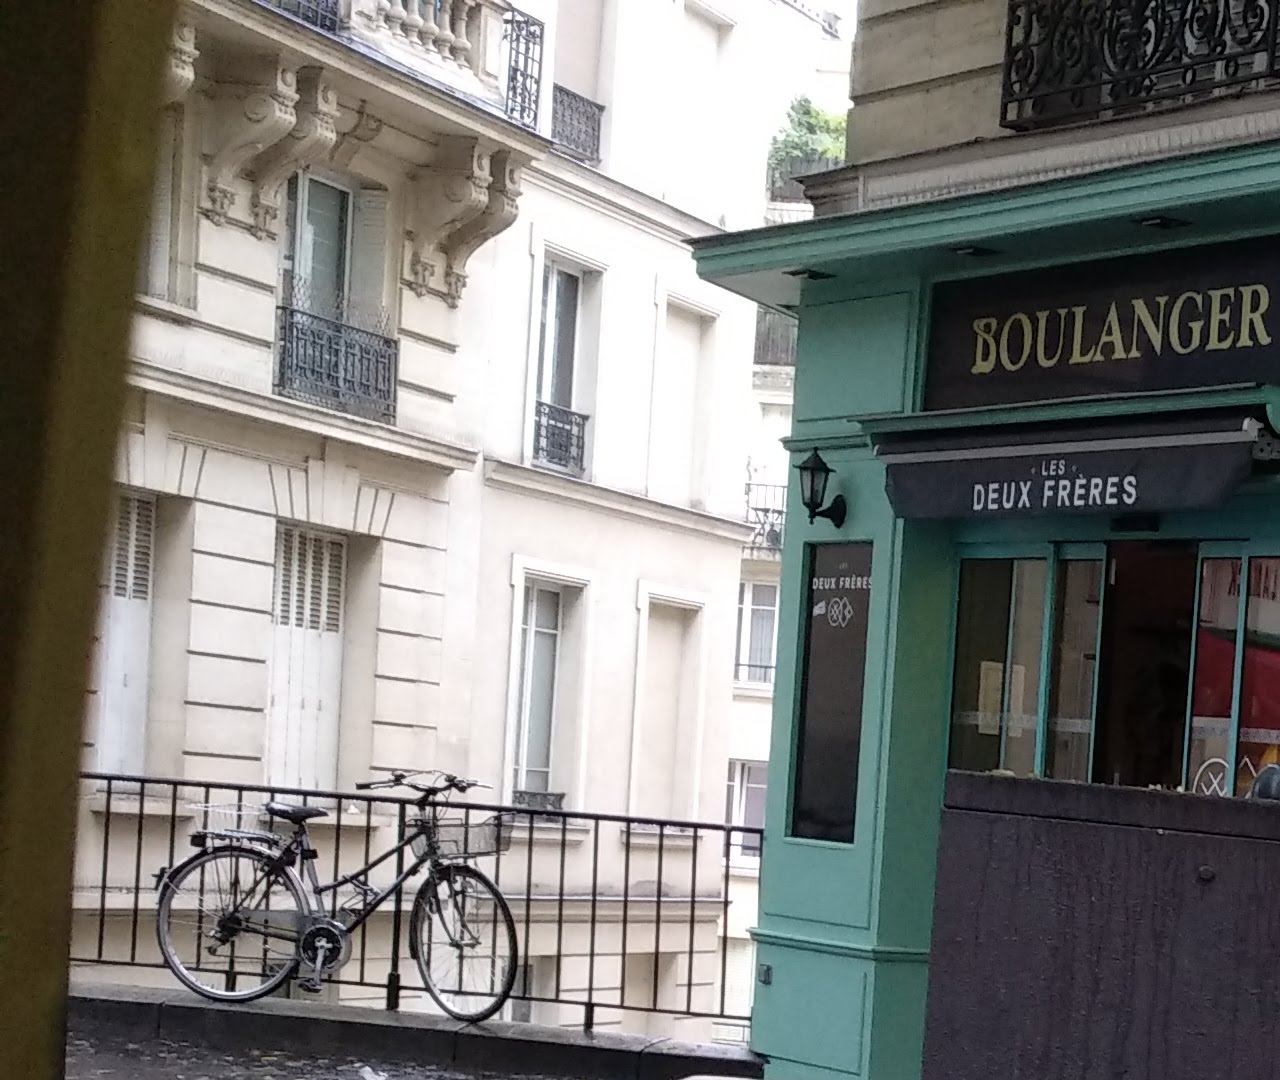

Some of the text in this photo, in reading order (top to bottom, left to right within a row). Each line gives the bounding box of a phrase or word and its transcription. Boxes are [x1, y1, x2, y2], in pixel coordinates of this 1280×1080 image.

[970, 284, 1273, 375] BOULANGER
[1041, 459, 1066, 476] LES
[972, 474, 1138, 511] DEUX FRÈRES
[812, 577, 837, 589] DEUX
